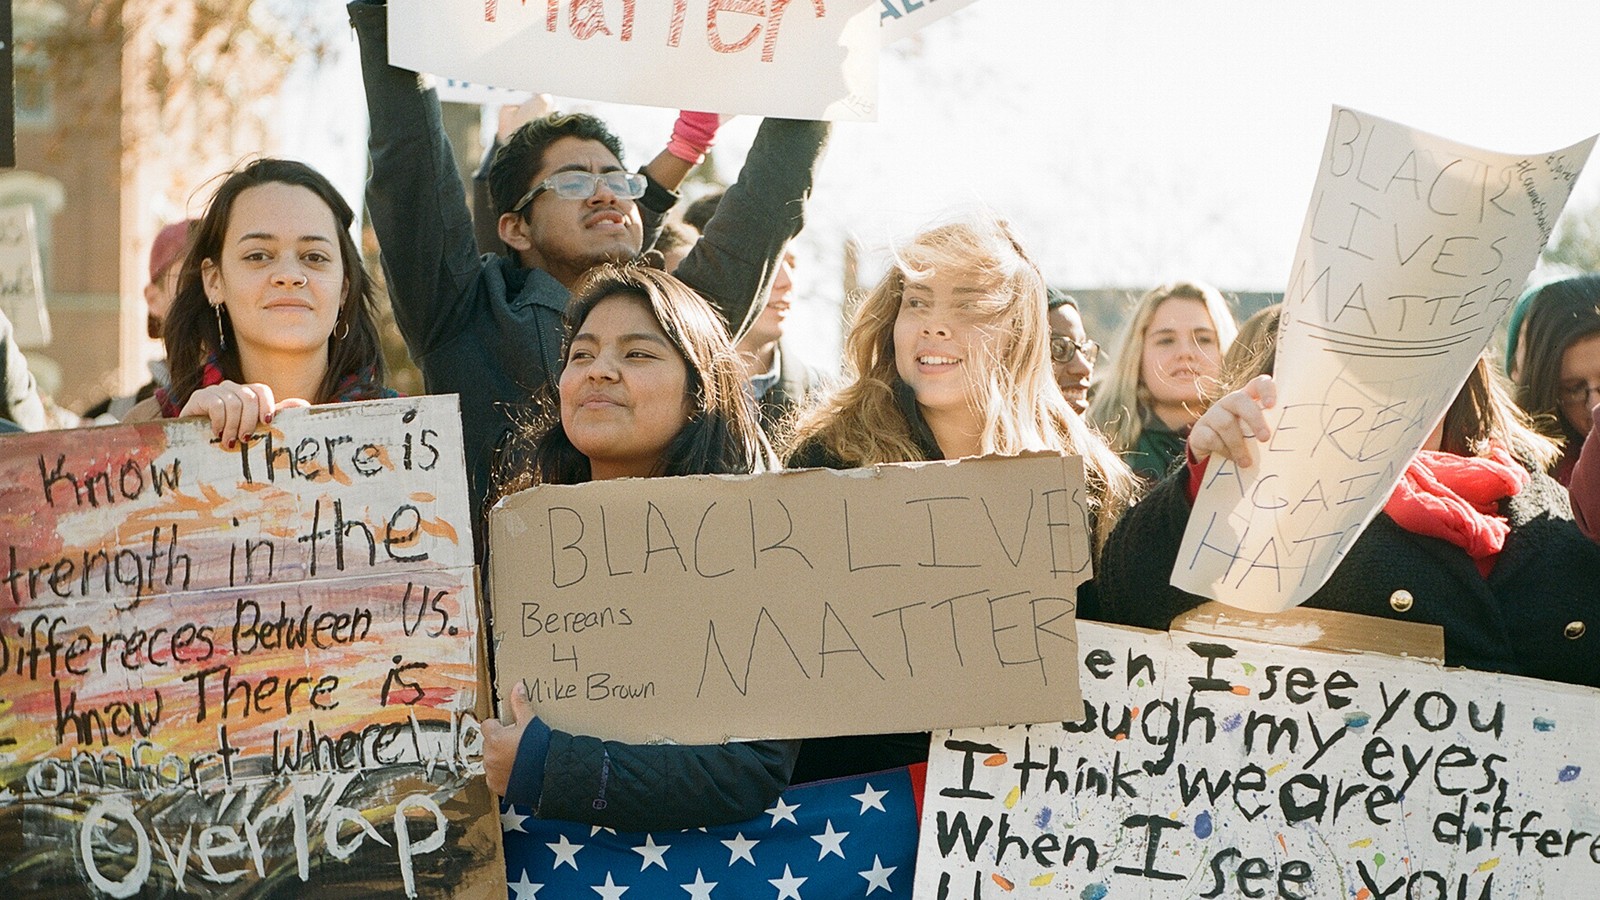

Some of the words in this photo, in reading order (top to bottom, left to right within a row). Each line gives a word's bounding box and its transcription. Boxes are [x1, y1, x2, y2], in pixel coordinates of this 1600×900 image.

[1330, 108, 1515, 223] BLACK
[1309, 190, 1507, 278] LIVES
[1286, 259, 1515, 335] MATTER
[38, 450, 182, 508] Know
[209, 431, 383, 484] There
[401, 408, 441, 471] is
[1, 523, 192, 612] trength
[228, 517, 274, 587] in
[298, 497, 429, 578] the
[548, 498, 813, 588] BLACK
[843, 487, 1091, 580] LIVES
[233, 597, 372, 656] Between
[521, 602, 633, 638] Bereans
[552, 643, 578, 672] 4
[696, 588, 1077, 698] MATTER
[183, 663, 339, 723] There
[379, 655, 429, 707] is
[522, 677, 577, 703] Mike
[586, 672, 655, 701] Brown
[1084, 647, 1157, 691] en
[1186, 641, 1238, 692] I
[1259, 664, 1359, 709] see
[1373, 681, 1505, 740] you
[24, 723, 243, 800] omfort
[1061, 688, 1218, 777] ough
[1243, 710, 1351, 770] my
[939, 740, 1007, 800] I
[1013, 736, 1143, 801] think
[1176, 762, 1272, 823] we
[1278, 772, 1402, 829] are
[936, 810, 1100, 873] When
[1113, 813, 1188, 881] I
[1199, 846, 1313, 900] see
